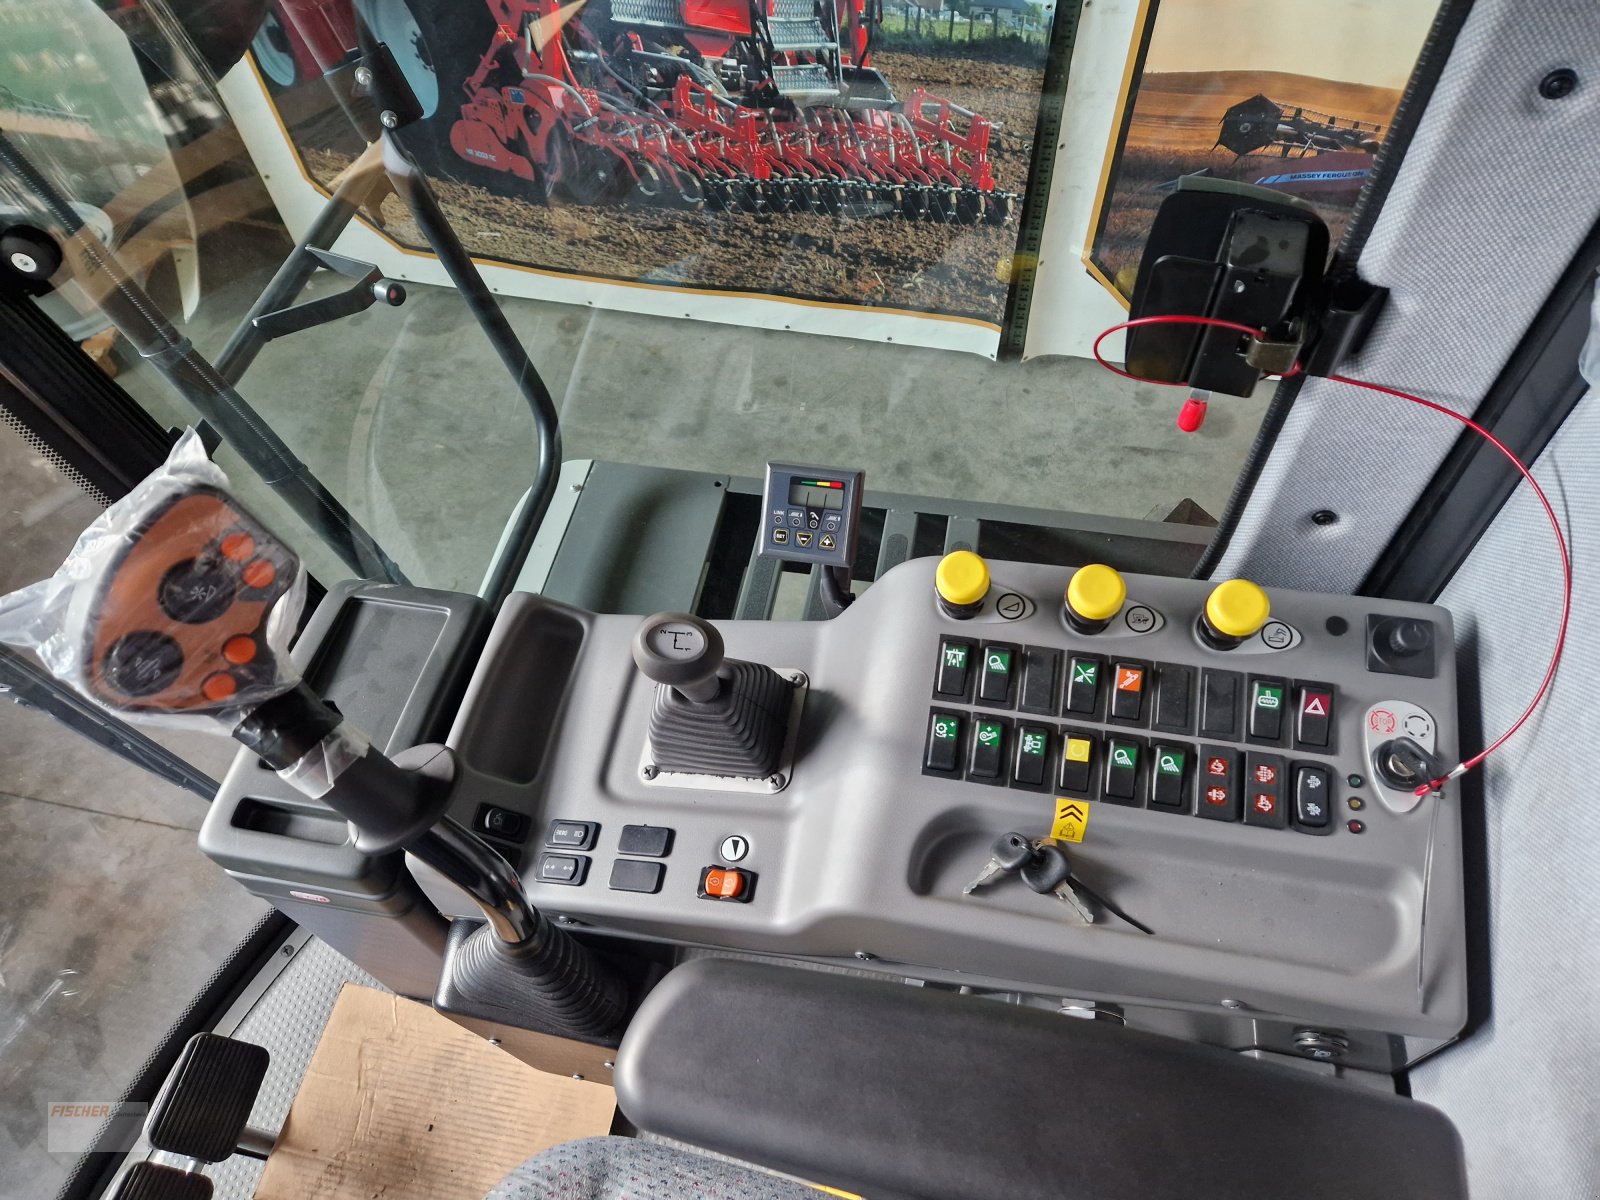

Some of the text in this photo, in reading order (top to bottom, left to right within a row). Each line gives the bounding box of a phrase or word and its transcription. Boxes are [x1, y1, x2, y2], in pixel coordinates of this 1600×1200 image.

[1290, 170, 1365, 180] MASSEY FERGUSON
[1374, 717, 1391, 725] STOP
